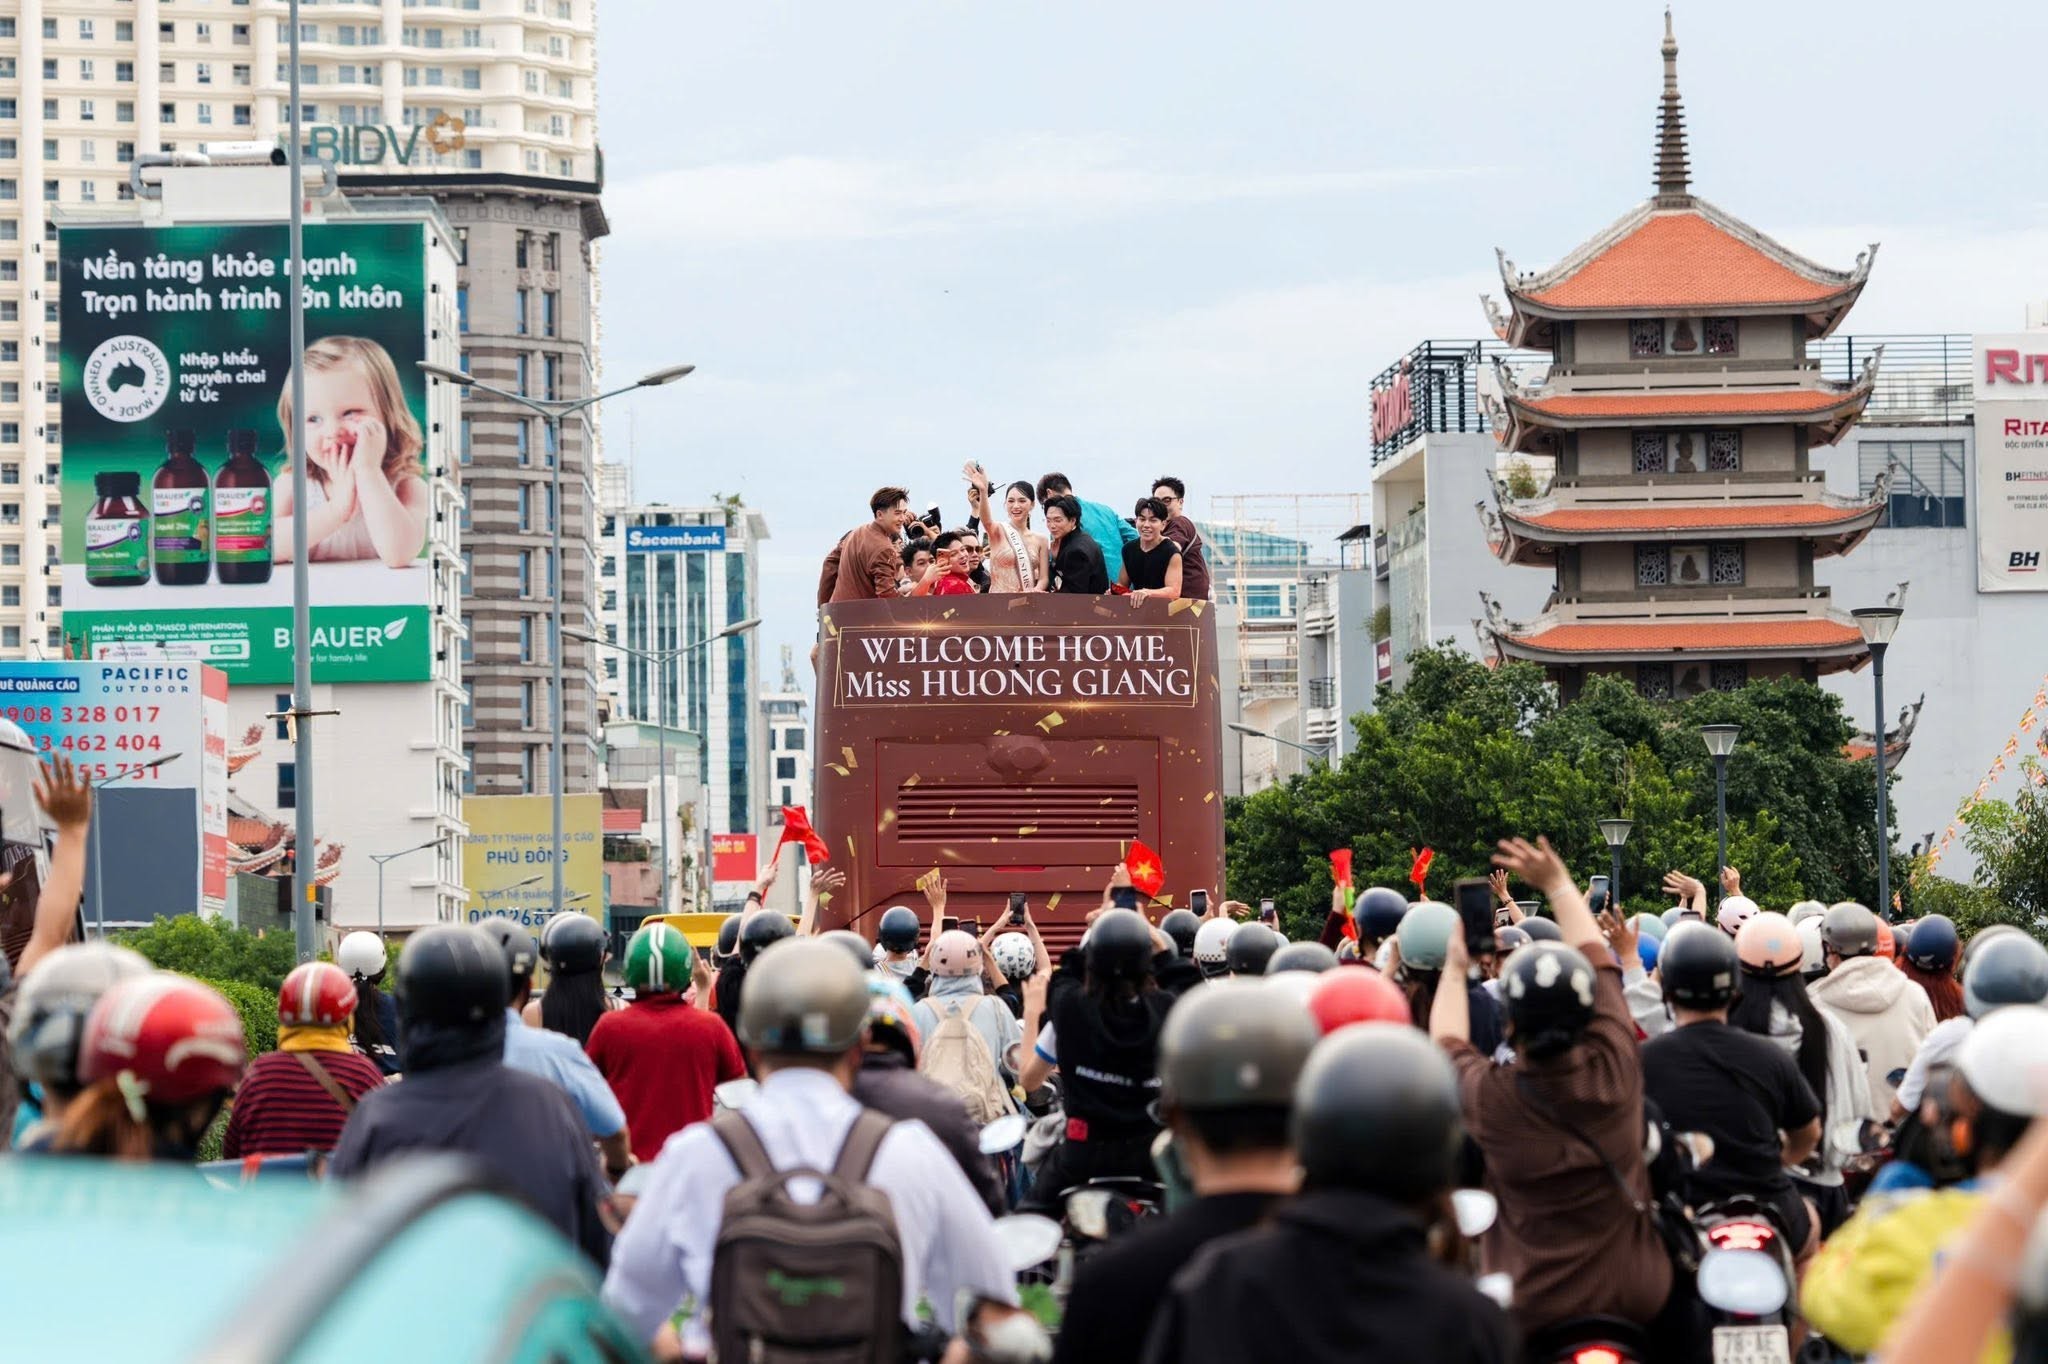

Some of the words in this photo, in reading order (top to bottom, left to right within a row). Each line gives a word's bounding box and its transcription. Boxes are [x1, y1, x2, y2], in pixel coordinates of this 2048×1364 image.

[310, 125, 422, 165] BIDV
[83, 248, 136, 280] Nền
[143, 253, 203, 284] tảng
[212, 251, 275, 278] khỏe
[81, 290, 137, 320] Trọn
[146, 286, 212, 312] hành
[219, 285, 281, 311] trình
[339, 283, 403, 309] khôn
[110, 341, 165, 387] AUSTRALIAN
[180, 352, 219, 369] Nhập
[222, 348, 259, 365] khẩu
[180, 370, 232, 388] nguyên
[236, 369, 266, 383] chai
[2005, 419, 2048, 435] RITA
[628, 531, 721, 547] Sacombank
[2009, 552, 2040, 567] BH
[156, 624, 187, 632] THASCO
[189, 622, 248, 631] INTERNATIONAL
[274, 627, 383, 648] BAUER
[861, 635, 1045, 664] WELCOME
[1057, 634, 1174, 666] HOME,
[102, 668, 188, 680] PACIFIC
[56, 679, 77, 690] CÁO
[103, 685, 188, 693] OUTDOOR
[846, 672, 911, 698] Miss
[921, 669, 1061, 697] HUONG
[1072, 668, 1191, 696] GIANG
[61, 707, 106, 722] 328
[115, 707, 160, 722] 017
[62, 736, 106, 751] 462
[115, 736, 161, 750] 404
